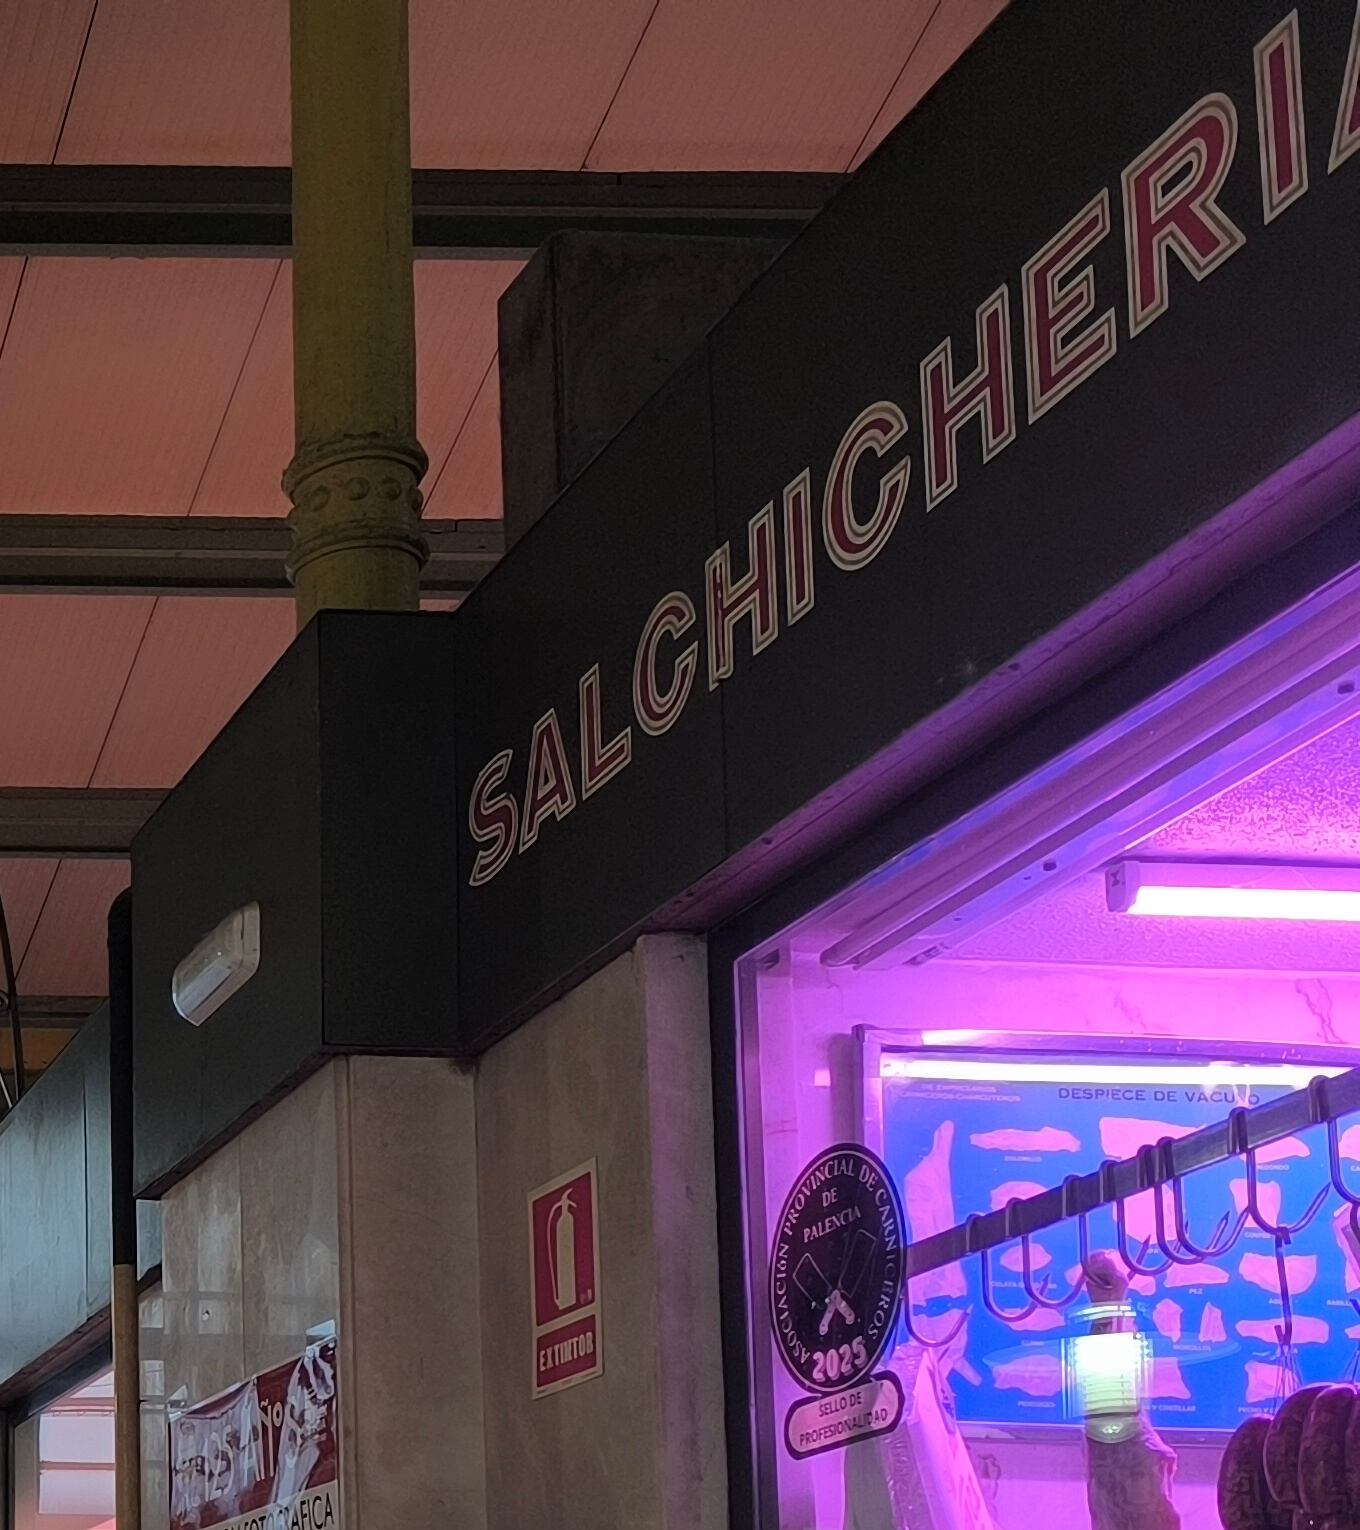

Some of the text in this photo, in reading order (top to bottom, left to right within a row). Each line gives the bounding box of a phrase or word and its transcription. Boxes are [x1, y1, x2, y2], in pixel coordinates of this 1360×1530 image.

[468, 4, 1360, 887] SALCHICHERI
[1058, 1086, 1148, 1102] DESPIECE
[1154, 1088, 1178, 1102] DE
[783, 1158, 855, 1236] PROVINCIAL
[858, 1163, 877, 1192] DE
[821, 1187, 838, 1208] DE
[803, 1205, 862, 1244] PALENCIA
[539, 1332, 594, 1372] EXTINTOR
[812, 1335, 868, 1383] 2025
[818, 1391, 863, 1418] SELLO DE
[799, 1407, 888, 1447] PROFESIONALIDAD
